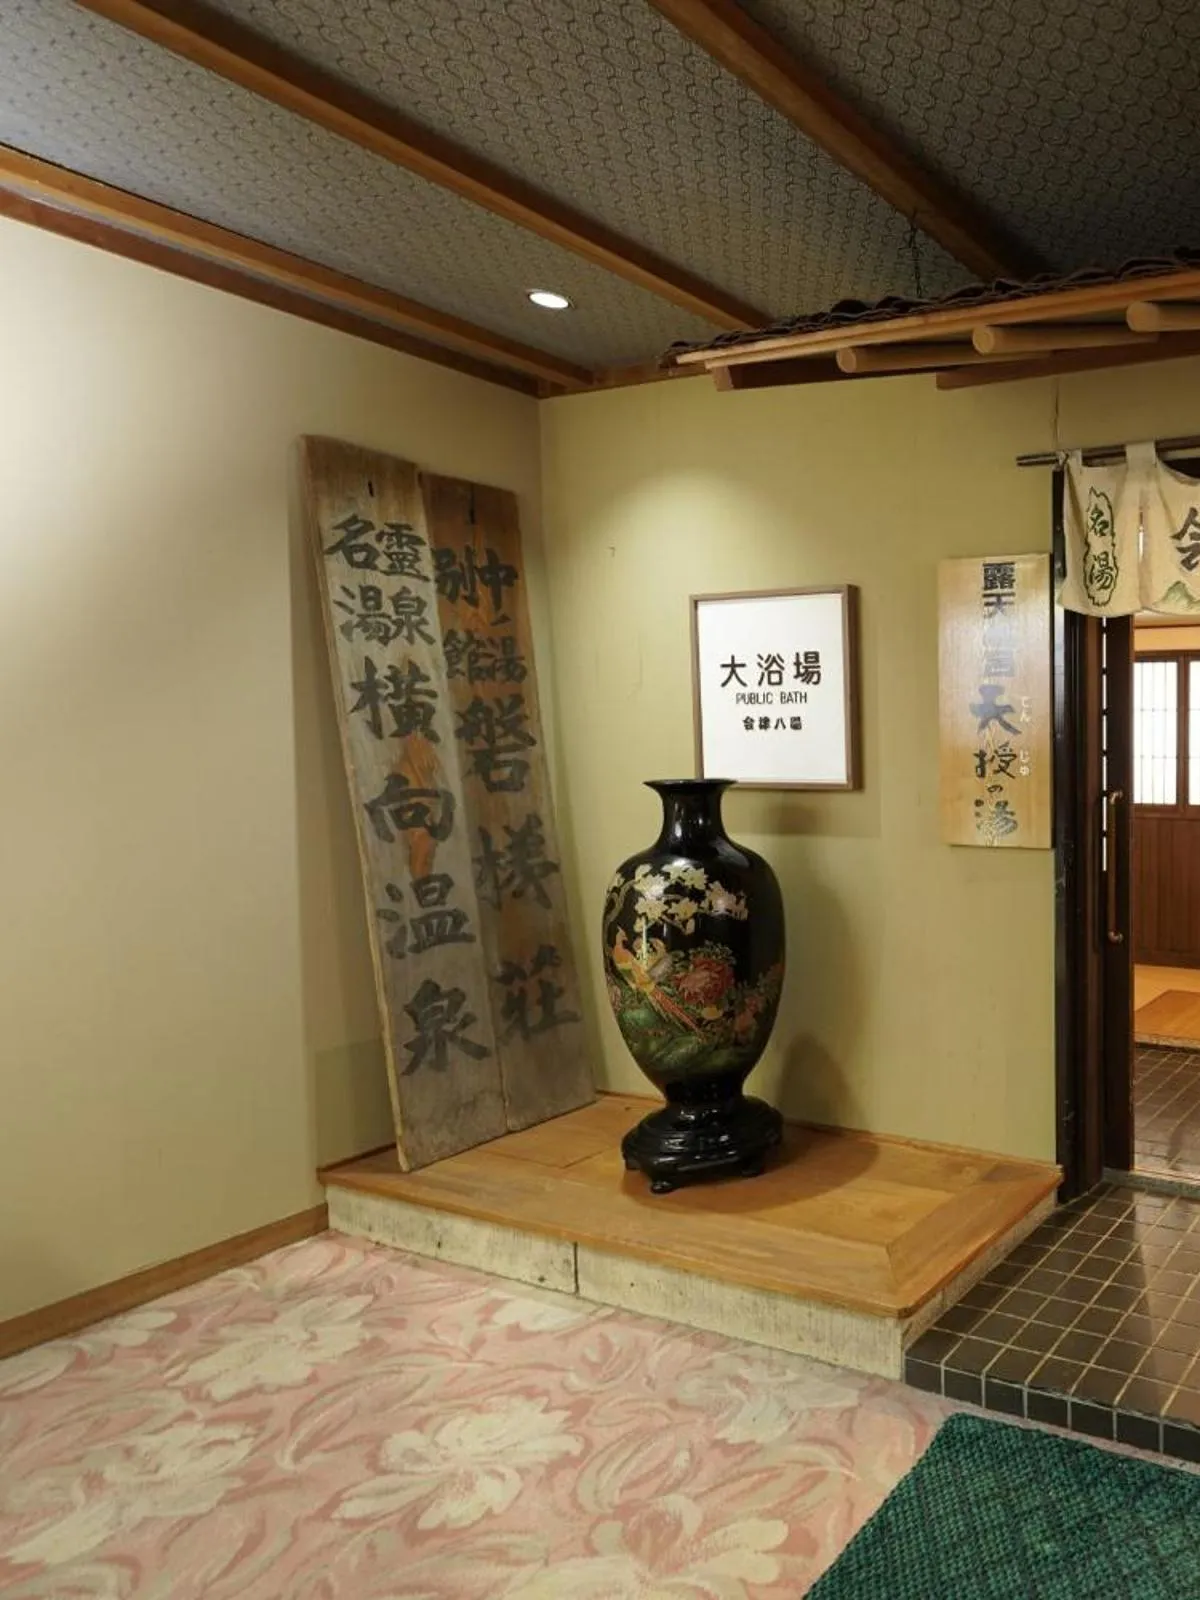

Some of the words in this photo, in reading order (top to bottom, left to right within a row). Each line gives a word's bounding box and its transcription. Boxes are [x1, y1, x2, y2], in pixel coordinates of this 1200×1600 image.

[1087, 504, 1114, 591] 名湯
[719, 650, 822, 688] 大浴場
[736, 692, 774, 705] PUBLIC
[780, 690, 808, 705] BATH
